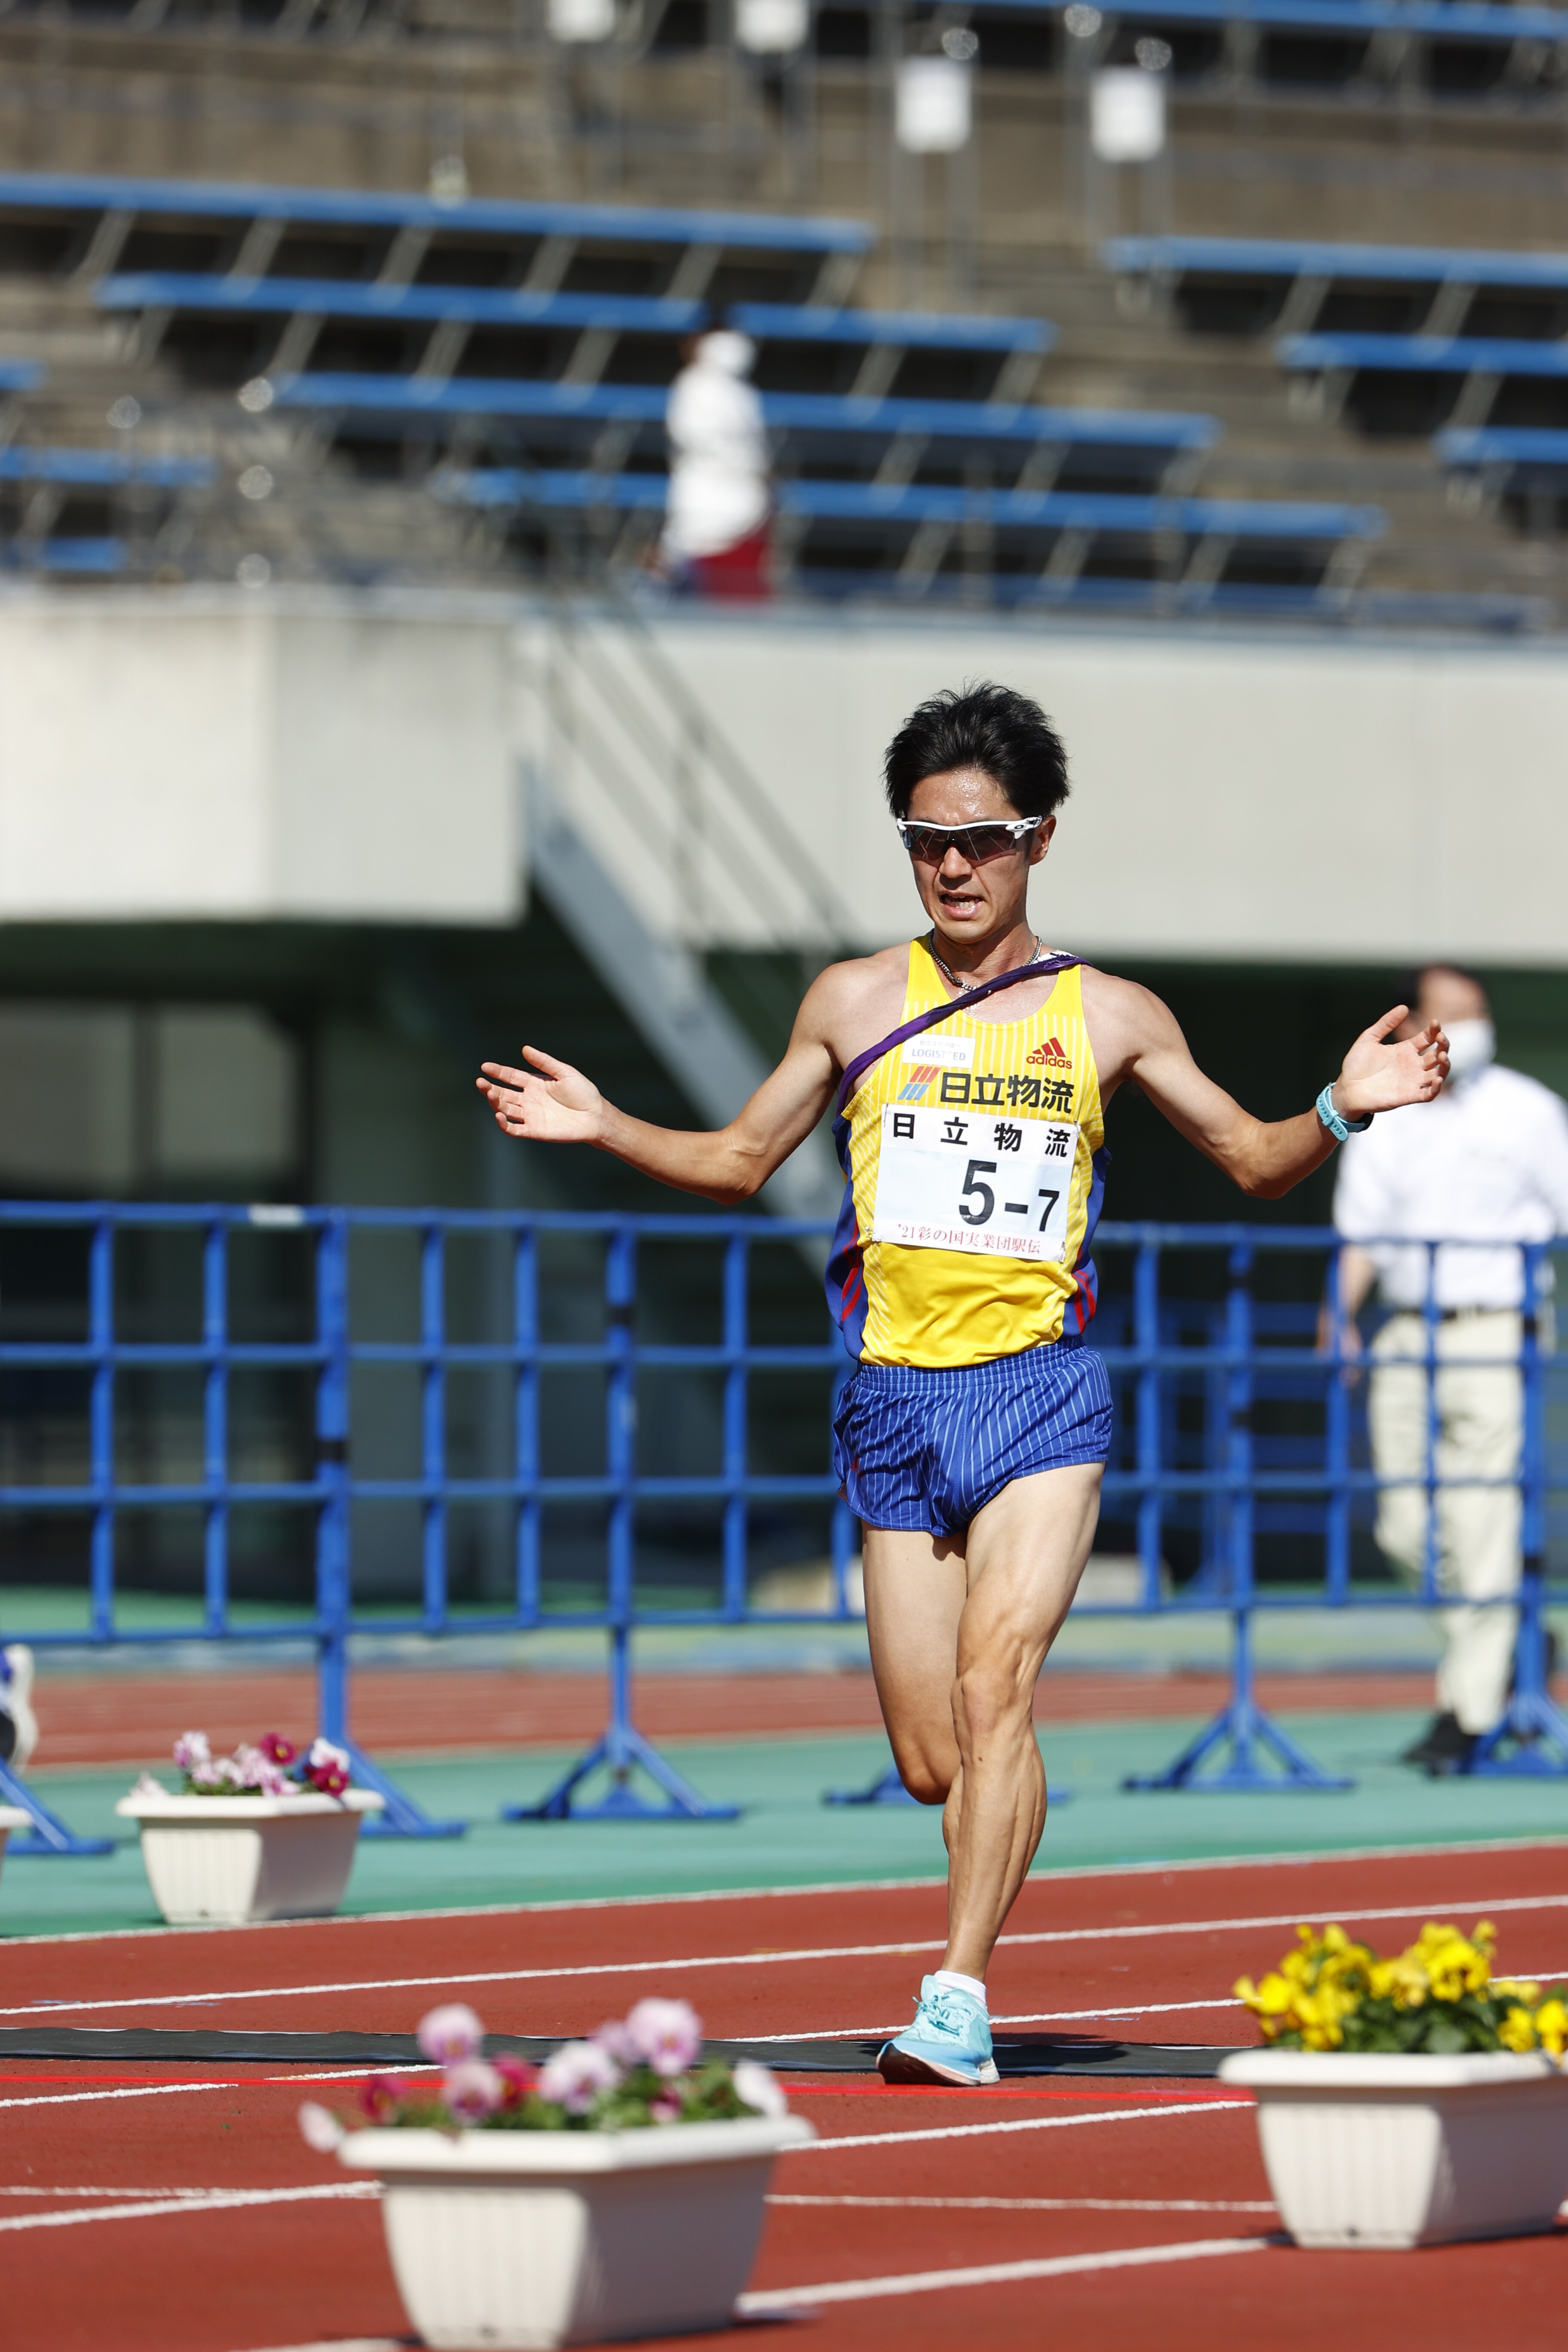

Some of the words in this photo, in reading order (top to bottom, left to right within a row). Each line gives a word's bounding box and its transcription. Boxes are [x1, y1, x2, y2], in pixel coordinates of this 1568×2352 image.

[1026, 1054, 1072, 1069] adidas
[940, 1072, 1074, 1113] 日立物流
[894, 1113, 1071, 1157] 日立物流
[959, 1160, 1060, 1232] 5-7
